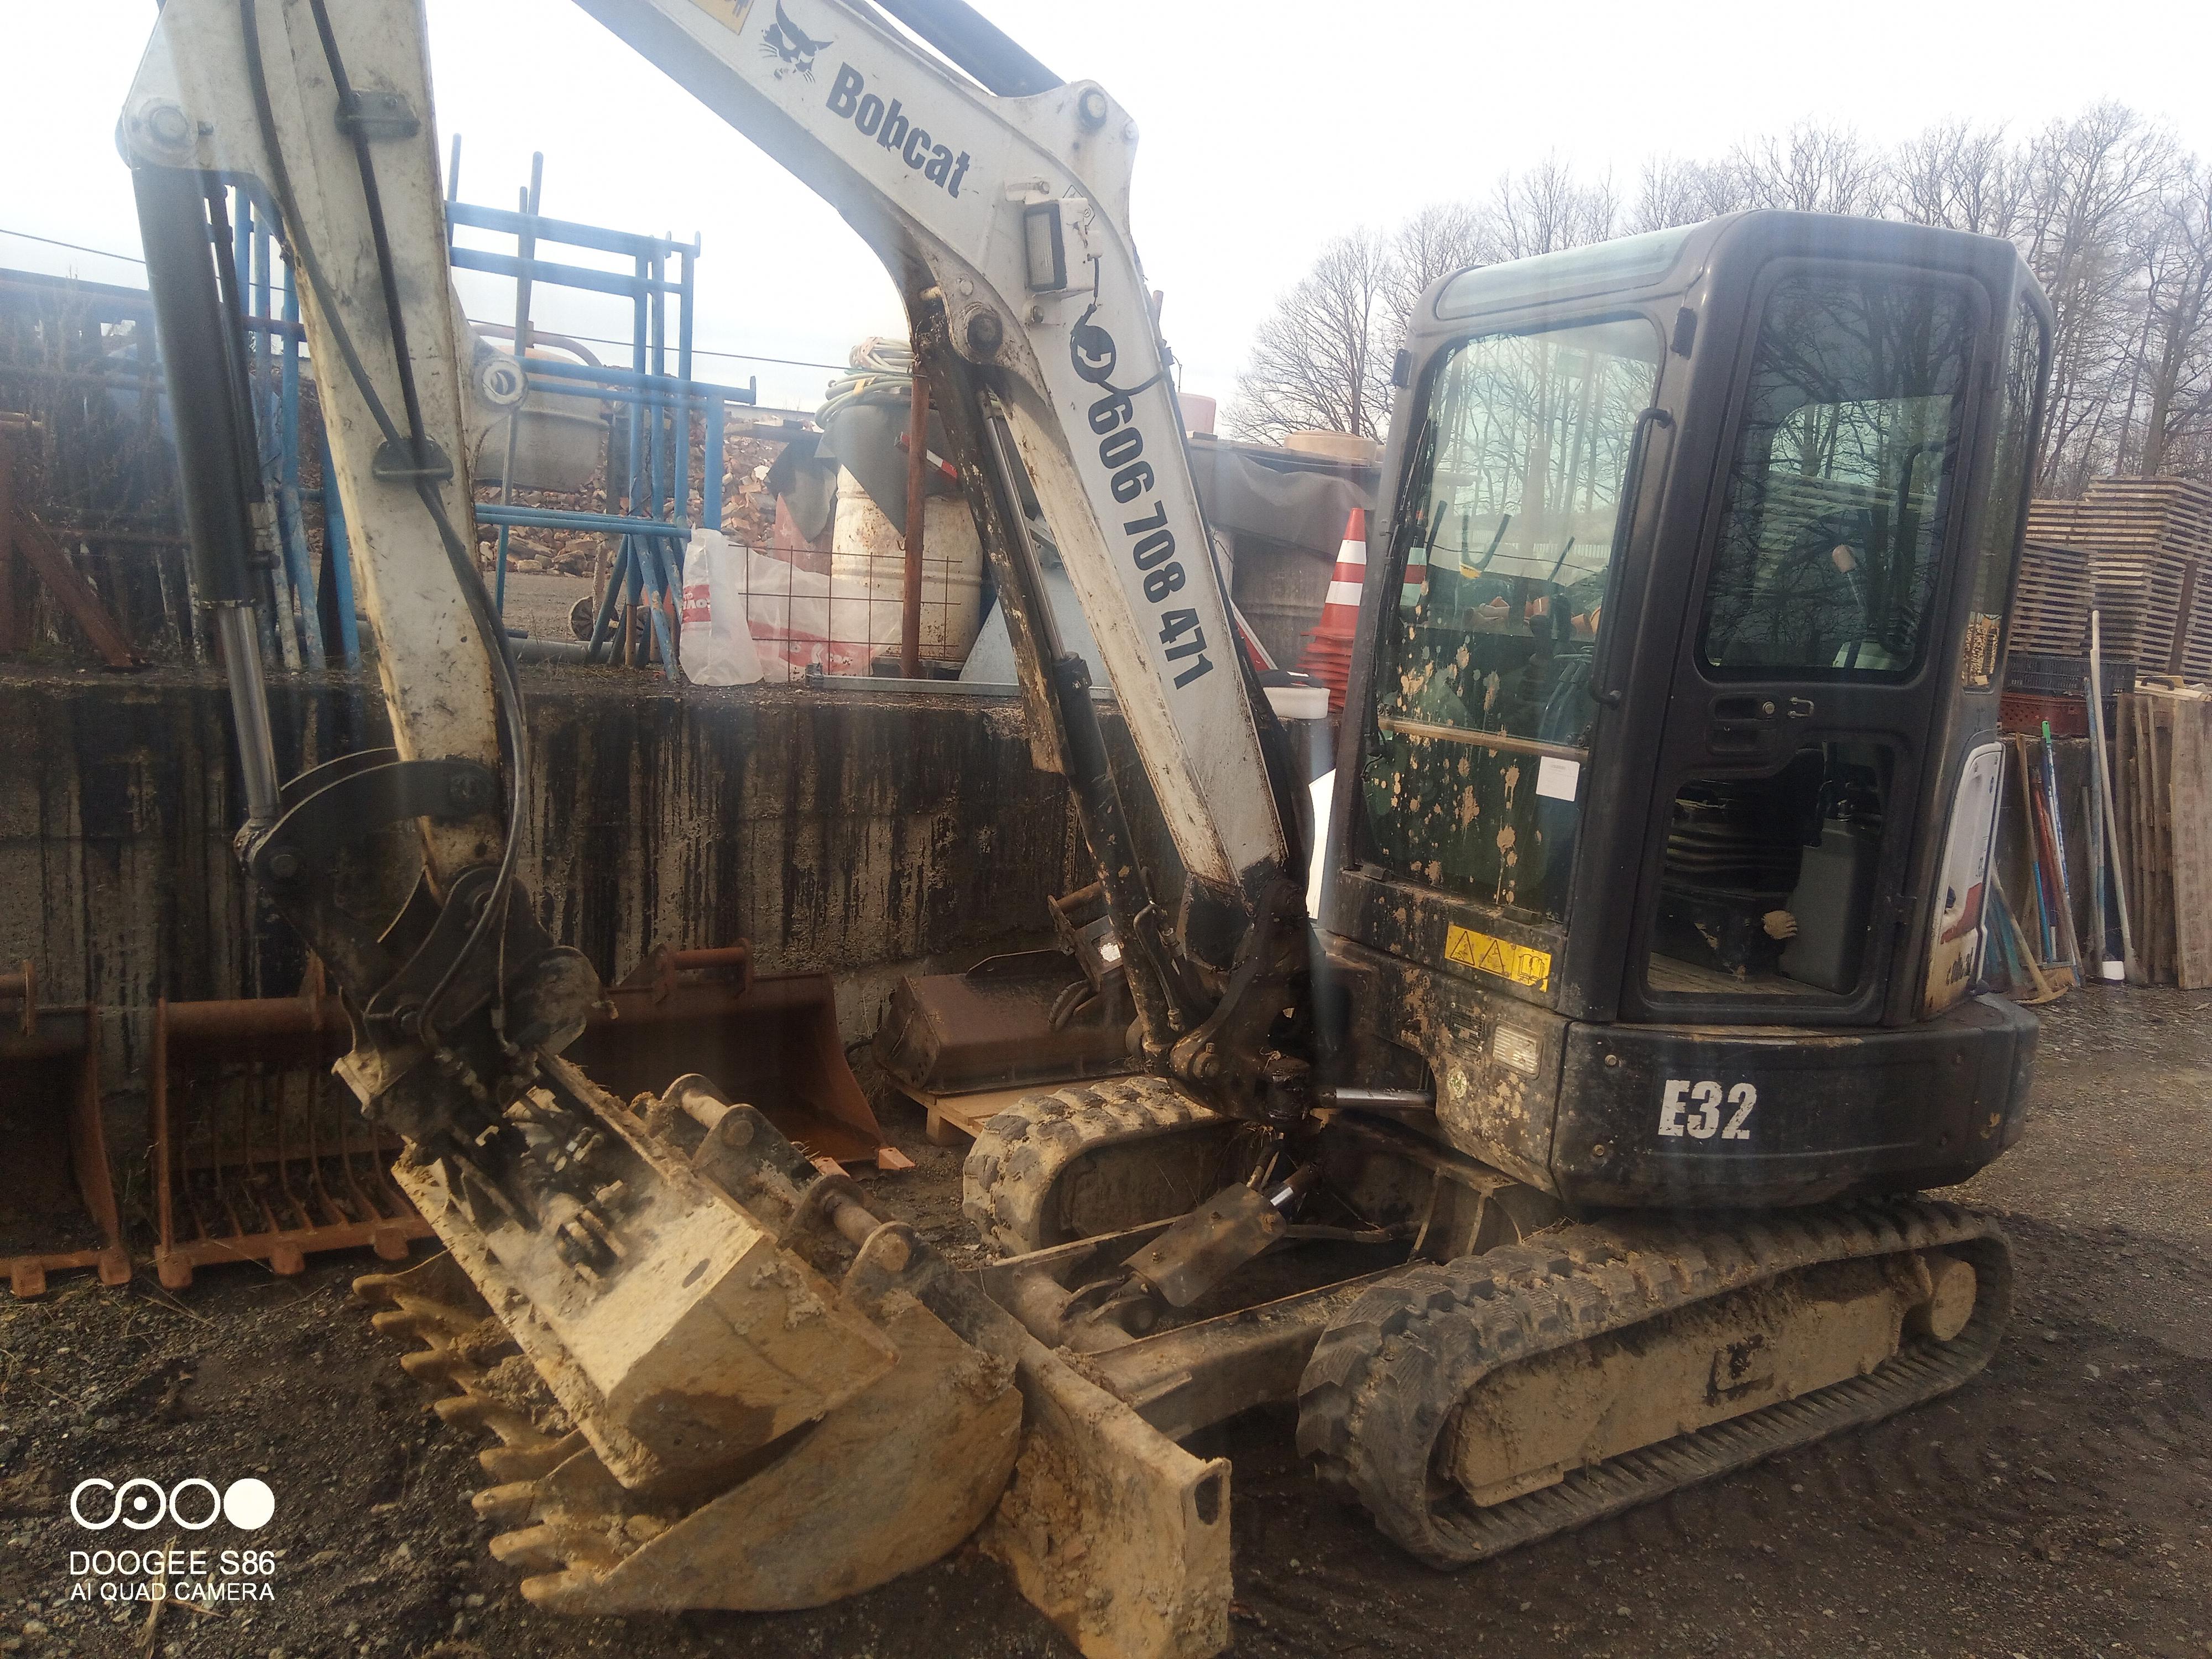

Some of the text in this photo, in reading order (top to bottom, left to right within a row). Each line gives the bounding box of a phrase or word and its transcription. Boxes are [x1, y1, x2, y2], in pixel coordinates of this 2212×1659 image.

[826, 62, 970, 199] Bobcat
[1088, 395, 1213, 690] 606 708 471
[1658, 1079, 1757, 1140] E32
